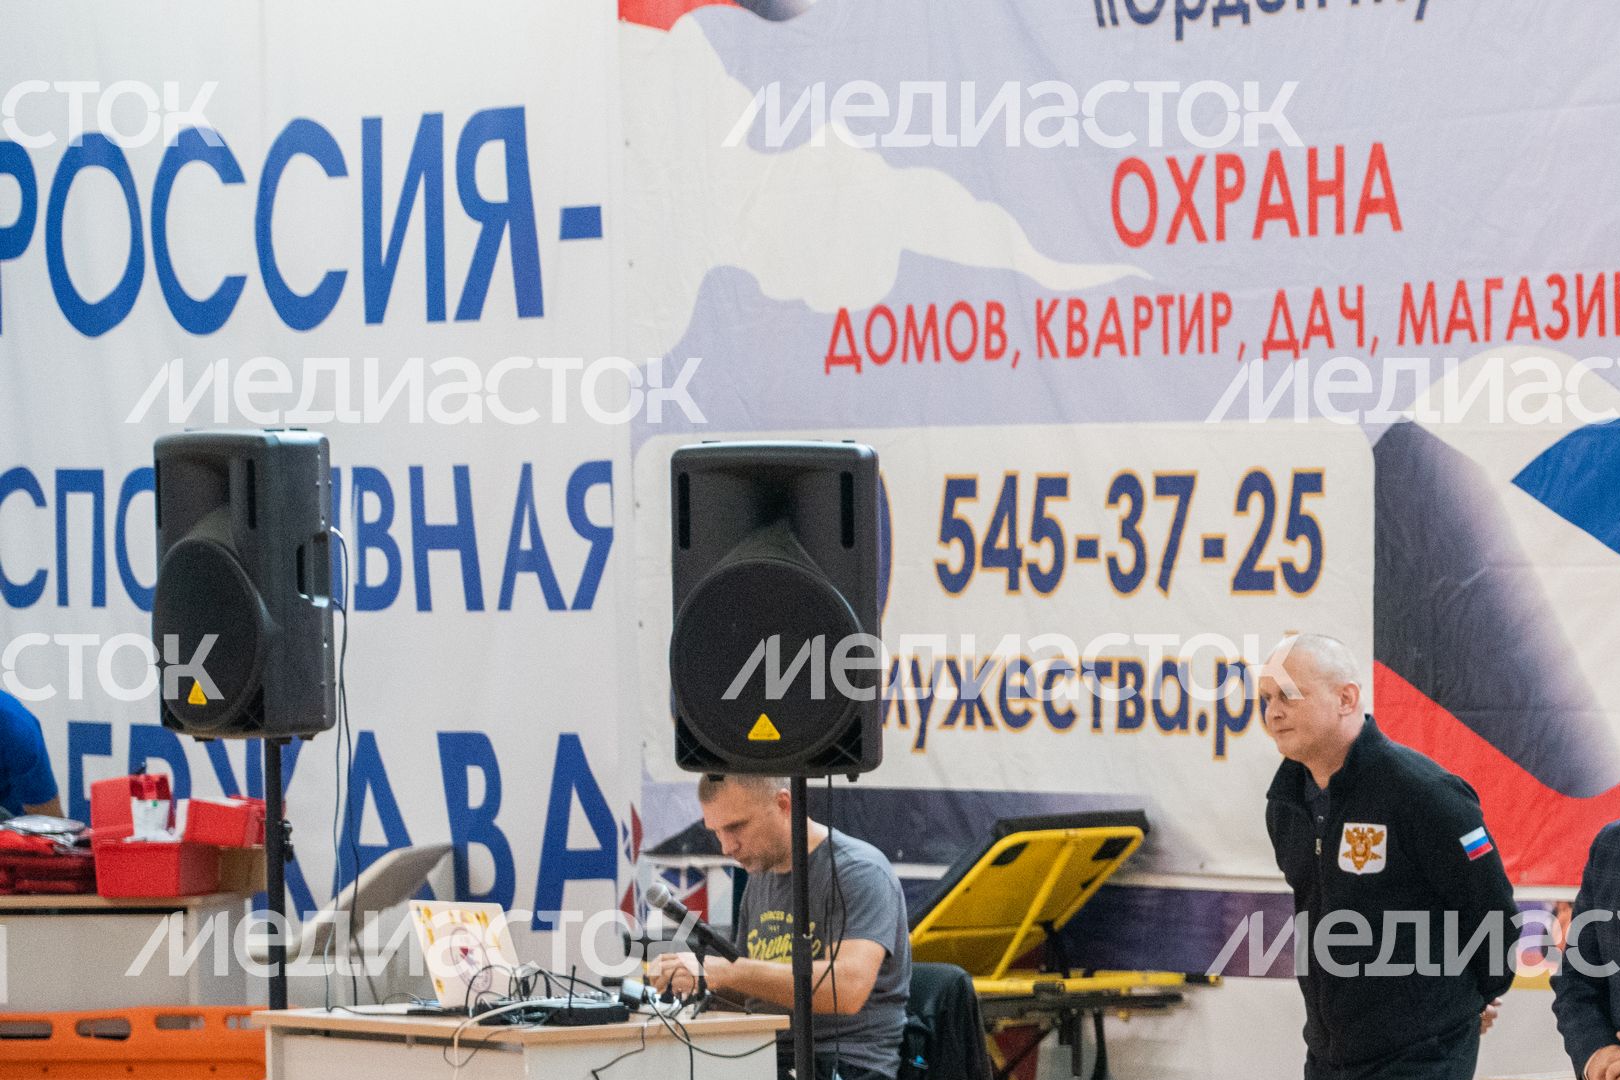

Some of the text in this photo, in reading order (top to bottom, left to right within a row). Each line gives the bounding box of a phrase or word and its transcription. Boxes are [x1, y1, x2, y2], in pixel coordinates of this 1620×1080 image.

[1109, 141, 1404, 249] ОХРАНА
[823, 301, 1023, 375] ДОМОВ,
[1034, 292, 1246, 362] КВАРТИР,
[1261, 285, 1381, 361] ДАЧ,
[934, 467, 1326, 597] 545-37-25
